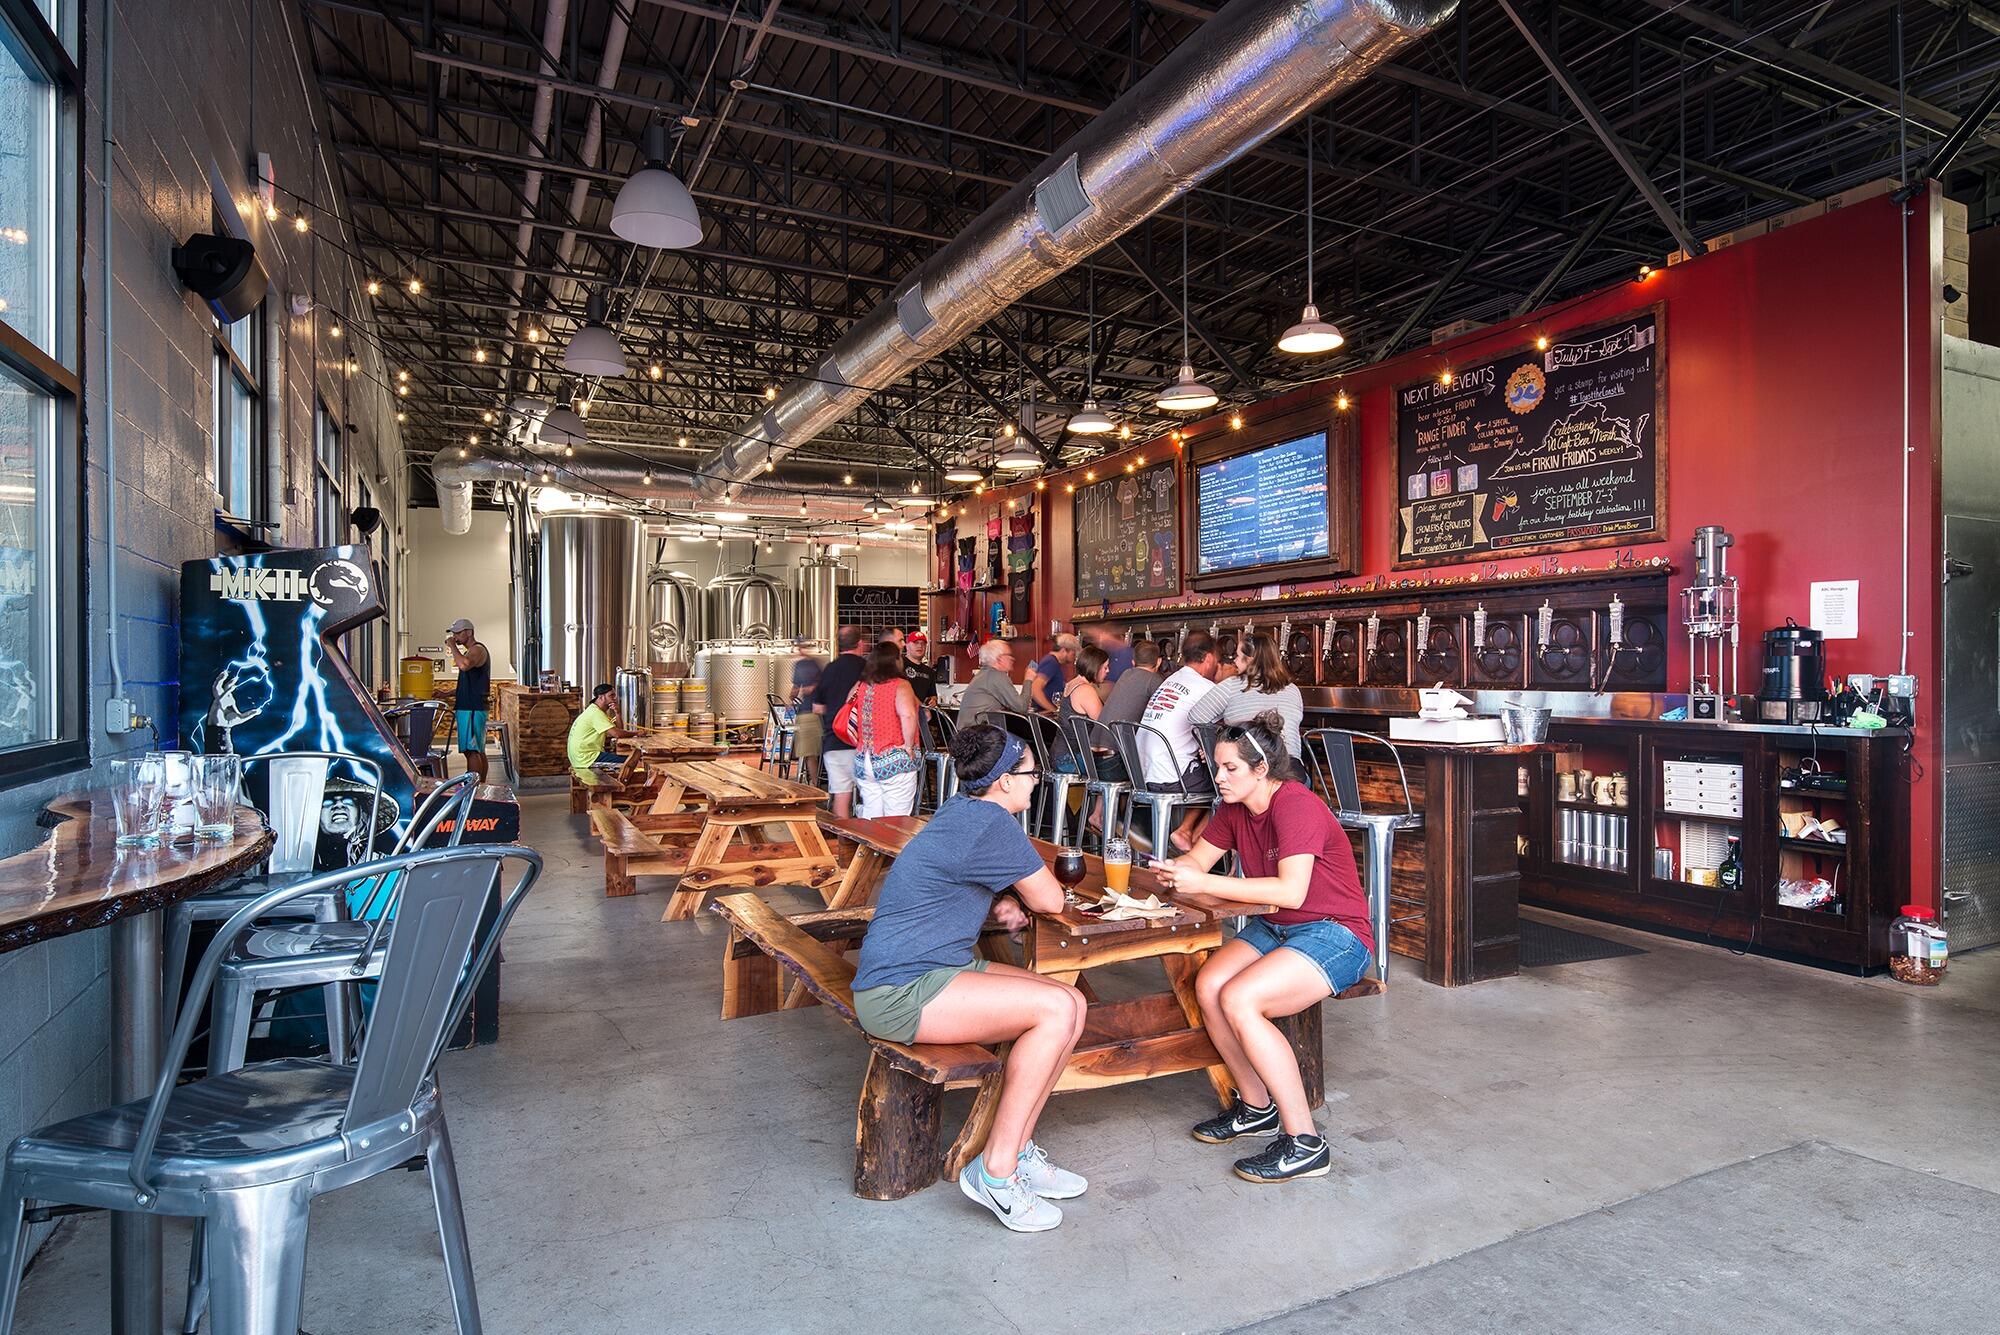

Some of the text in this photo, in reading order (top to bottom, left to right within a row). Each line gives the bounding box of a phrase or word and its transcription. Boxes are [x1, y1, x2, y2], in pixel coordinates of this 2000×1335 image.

[1555, 348, 1583, 365] July
[1599, 339, 1622, 358] Sept
[1404, 386, 1429, 406] NEXT
[1453, 365, 1495, 392] EVENTS
[1597, 371, 1607, 383] for
[1417, 397, 1477, 421] beer release FRIDAY
[1554, 415, 1598, 436] celebrating
[1573, 431, 1591, 447] Beer
[1590, 424, 1617, 443] Month
[1531, 454, 1560, 472] FIRKIN
[1562, 447, 1597, 467] FRIDAYS
[1598, 445, 1624, 457] WEEKLY!
[1530, 468, 1636, 504] join us all weekend
[1415, 497, 1467, 519] please remember
[1544, 490, 1593, 511] SEPTEMBER
[1518, 516, 1530, 531] for
[1595, 503, 1632, 515] celebrations
[1566, 525, 1601, 537] PASSWORD:
[1481, 563, 1498, 580] 12
[1541, 557, 1559, 575] 13
[1615, 549, 1633, 567] 14
[219, 566, 302, 602] MKII
[435, 818, 500, 833] MIWAY
